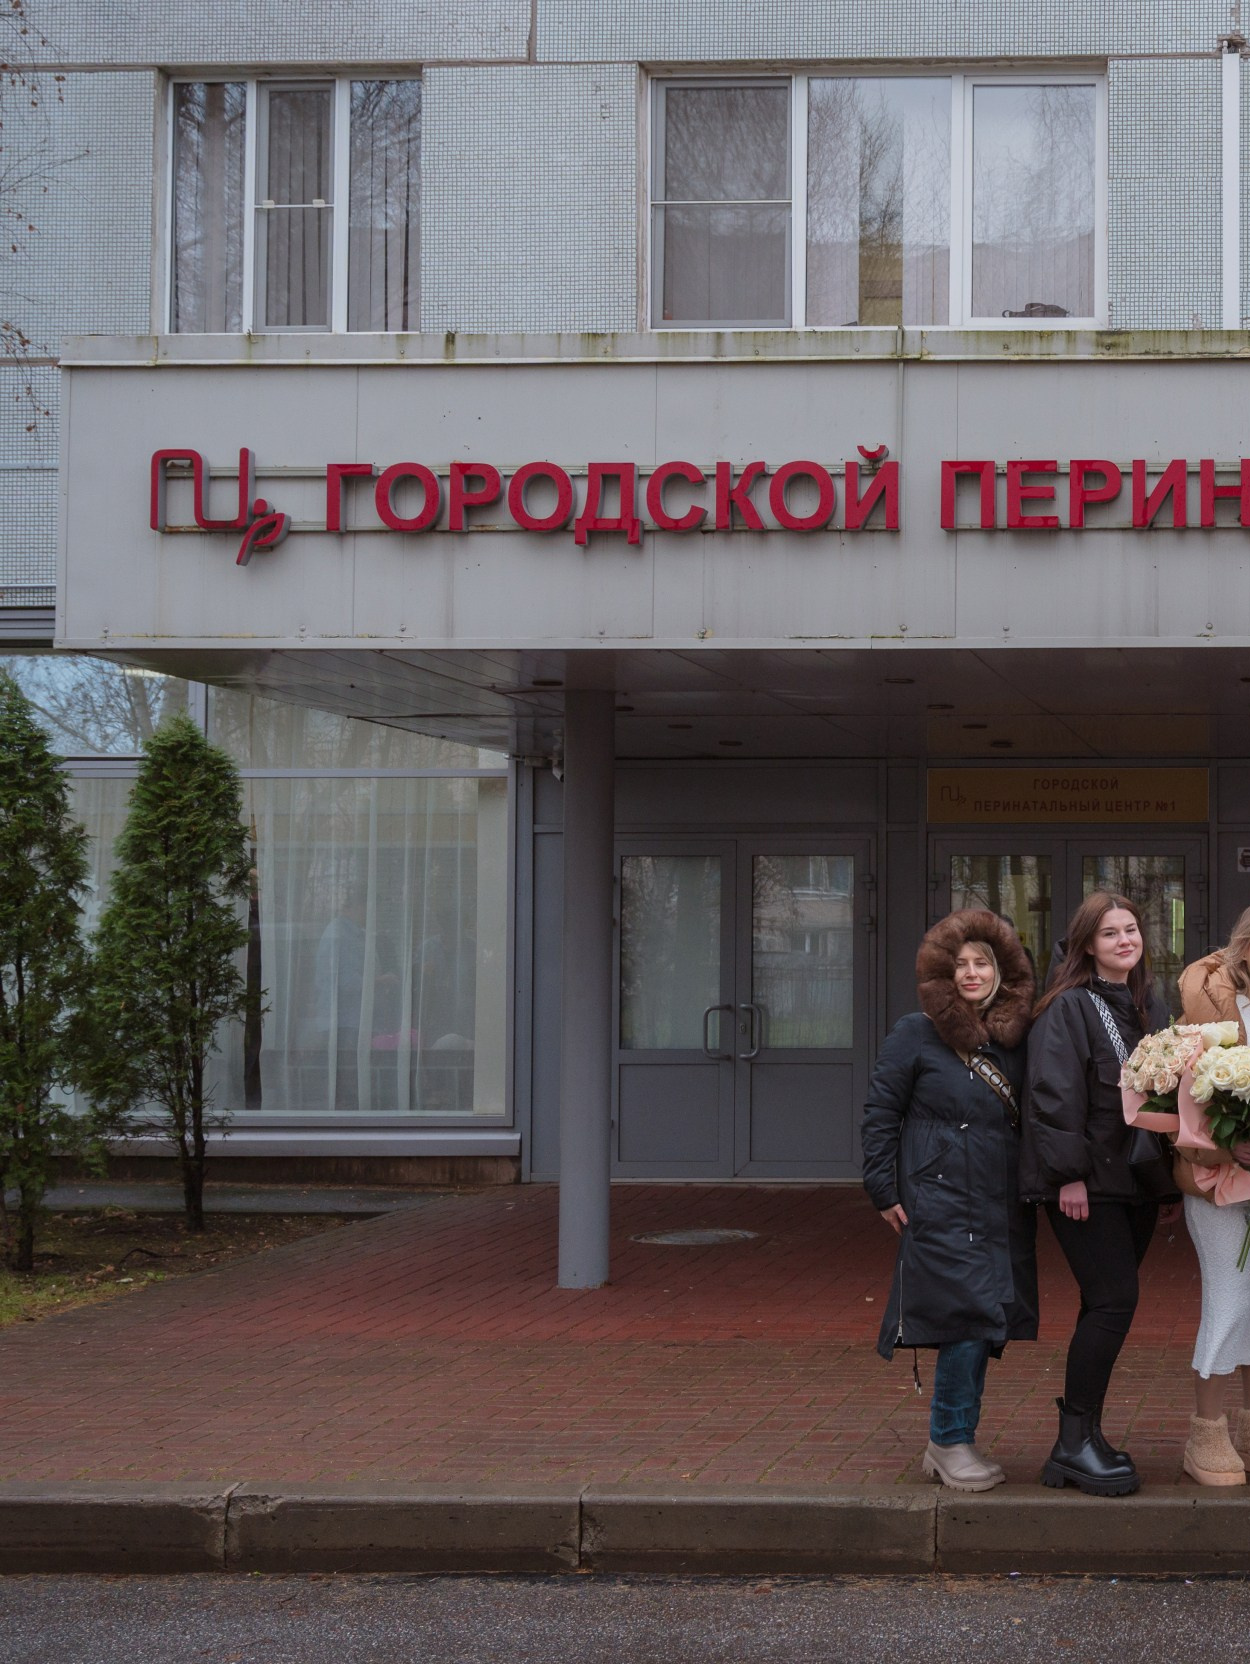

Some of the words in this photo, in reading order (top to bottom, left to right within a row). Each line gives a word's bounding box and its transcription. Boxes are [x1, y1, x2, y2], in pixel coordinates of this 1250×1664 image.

[326, 444, 899, 546] ГОРОДСКОЙ
[1033, 777, 1120, 792] ГОРОДСКОЙ
[973, 799, 1101, 812] ПЕРИНАТАЛЬНЫЙ
[1105, 800, 1151, 814] ЦЕНТР
[1154, 800, 1177, 812] №1
